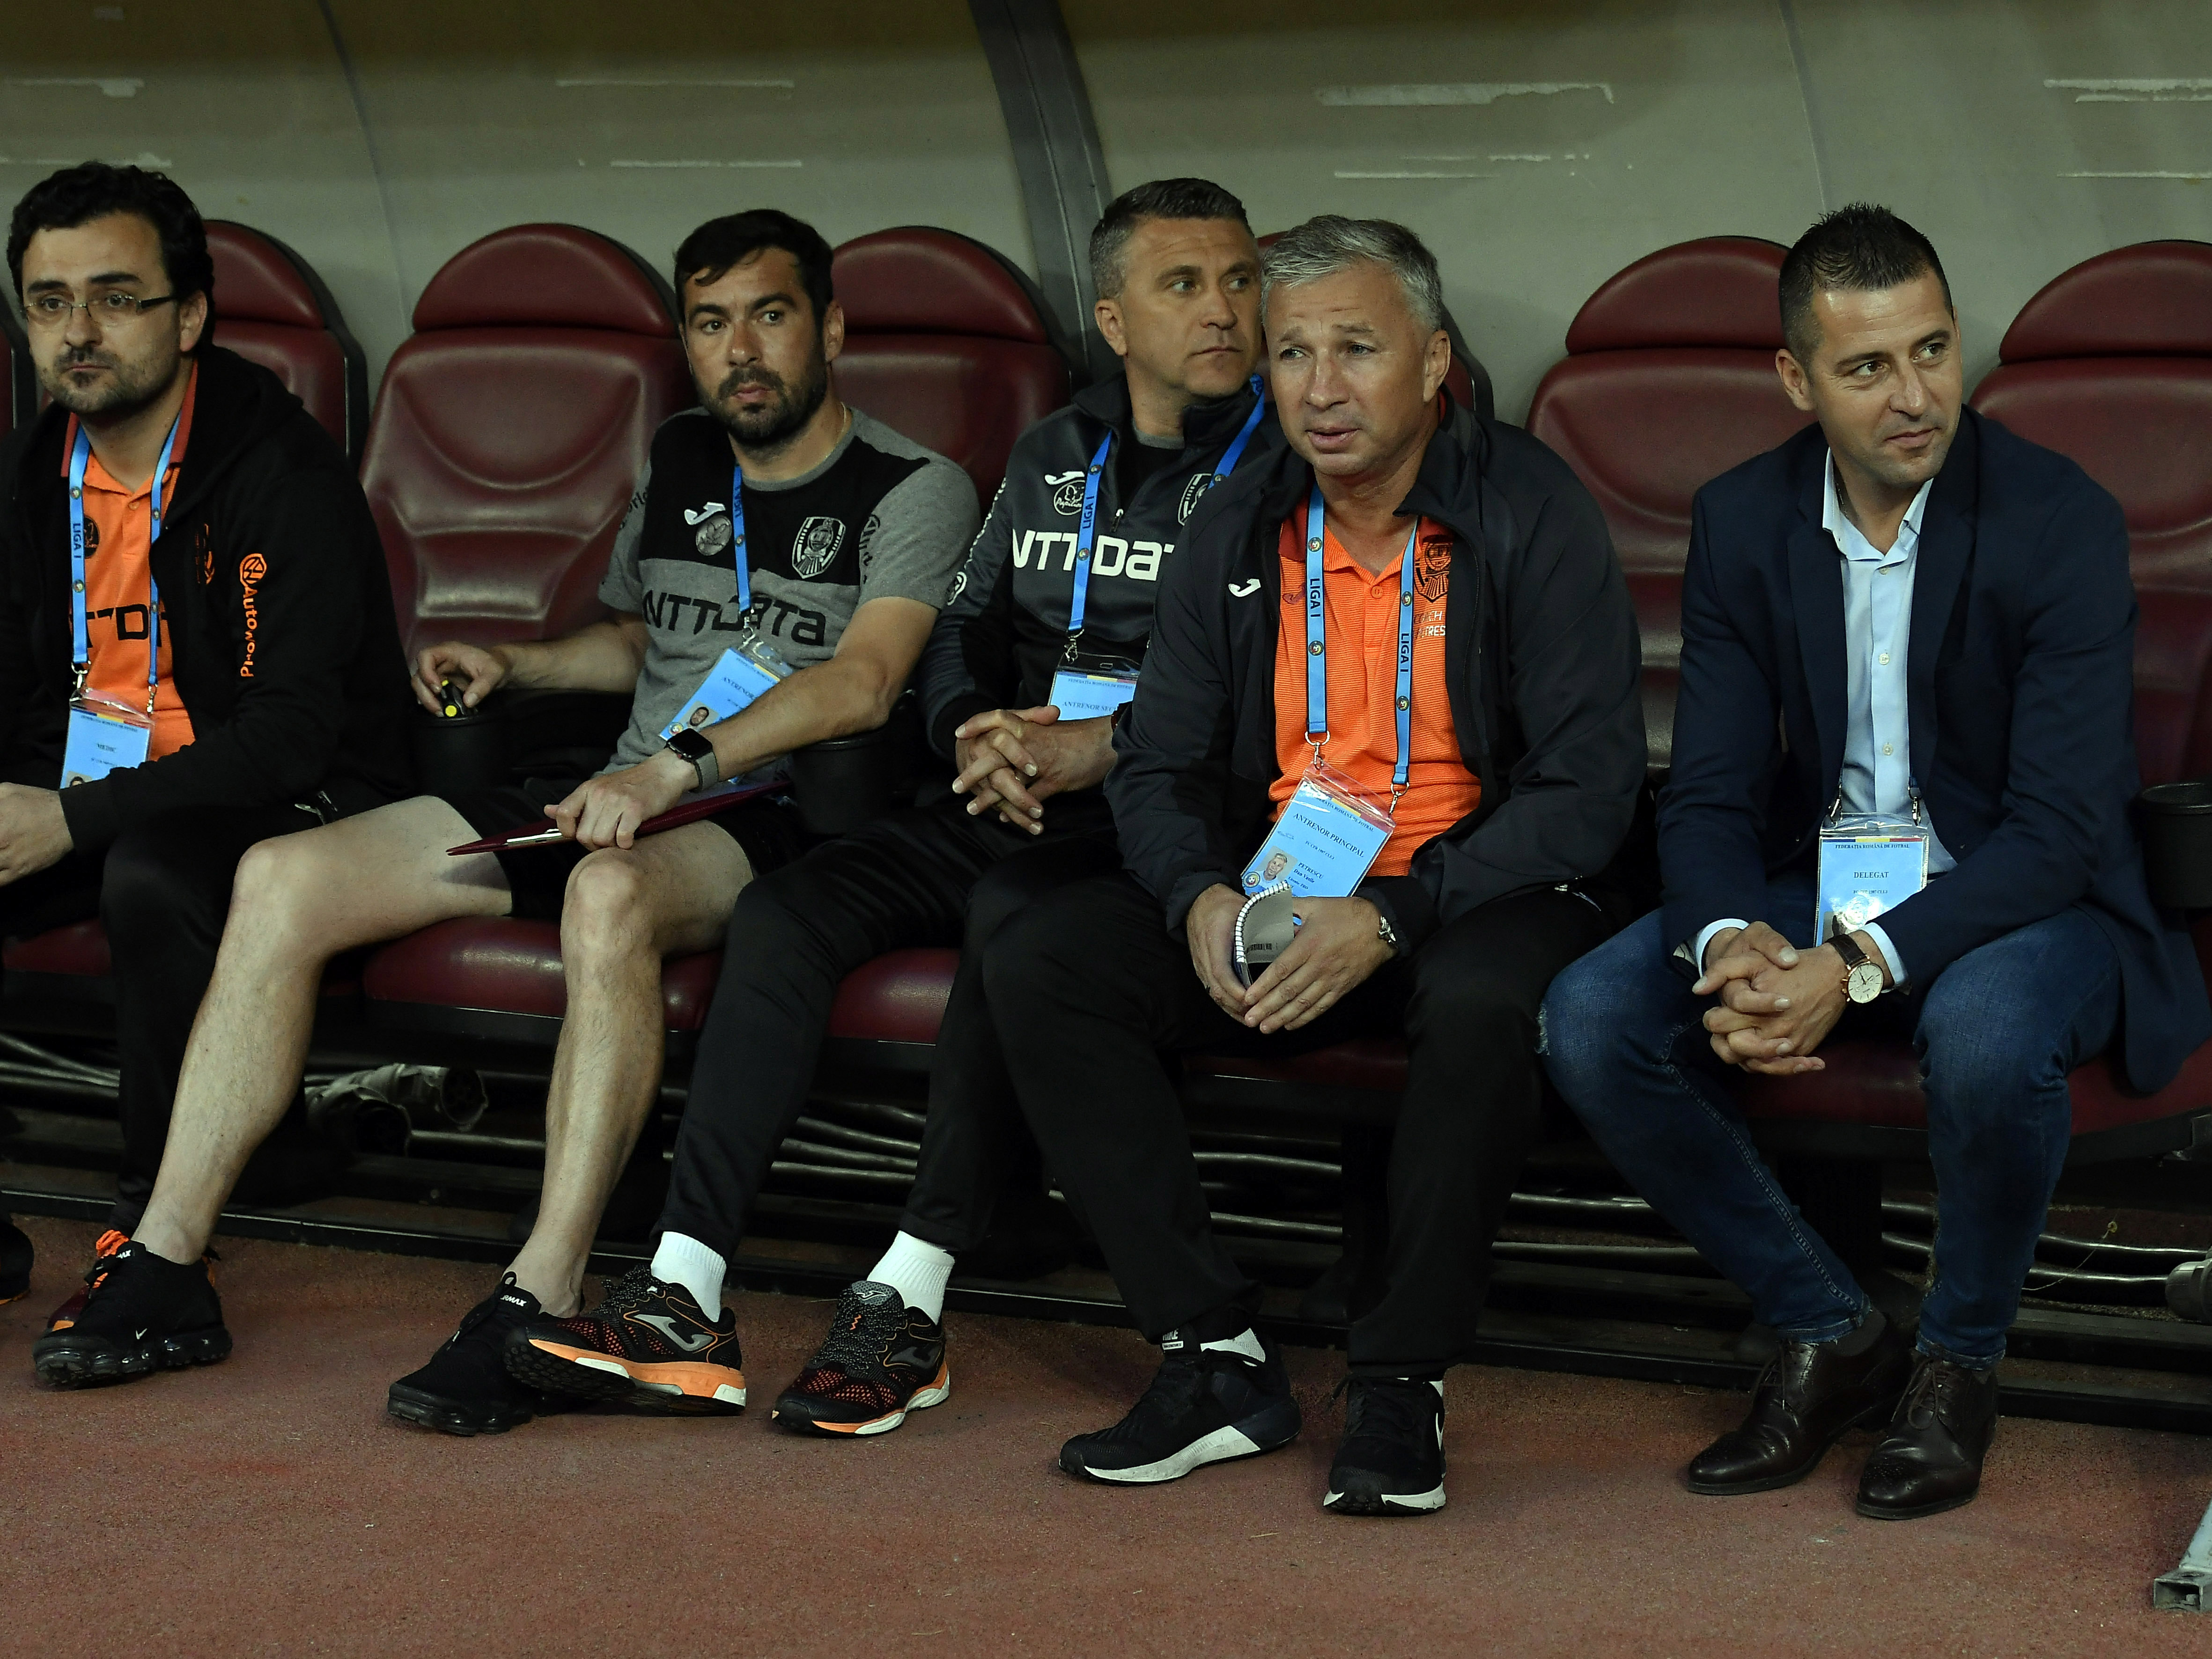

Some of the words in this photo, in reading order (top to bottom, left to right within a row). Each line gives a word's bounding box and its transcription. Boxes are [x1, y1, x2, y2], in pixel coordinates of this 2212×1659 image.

[1082, 503, 1095, 529] LIGA
[73, 523, 82, 551] LIGA
[1309, 578, 1321, 610] LIGA
[1400, 633, 1409, 664] LIGA
[1062, 701, 1100, 711] ANTRENOR
[1293, 813, 1330, 837] ANTRENOR
[1329, 833, 1364, 858] PRINCIPAL
[1298, 862, 1324, 879] PETRESCU
[1303, 874, 1315, 884] Vasile
